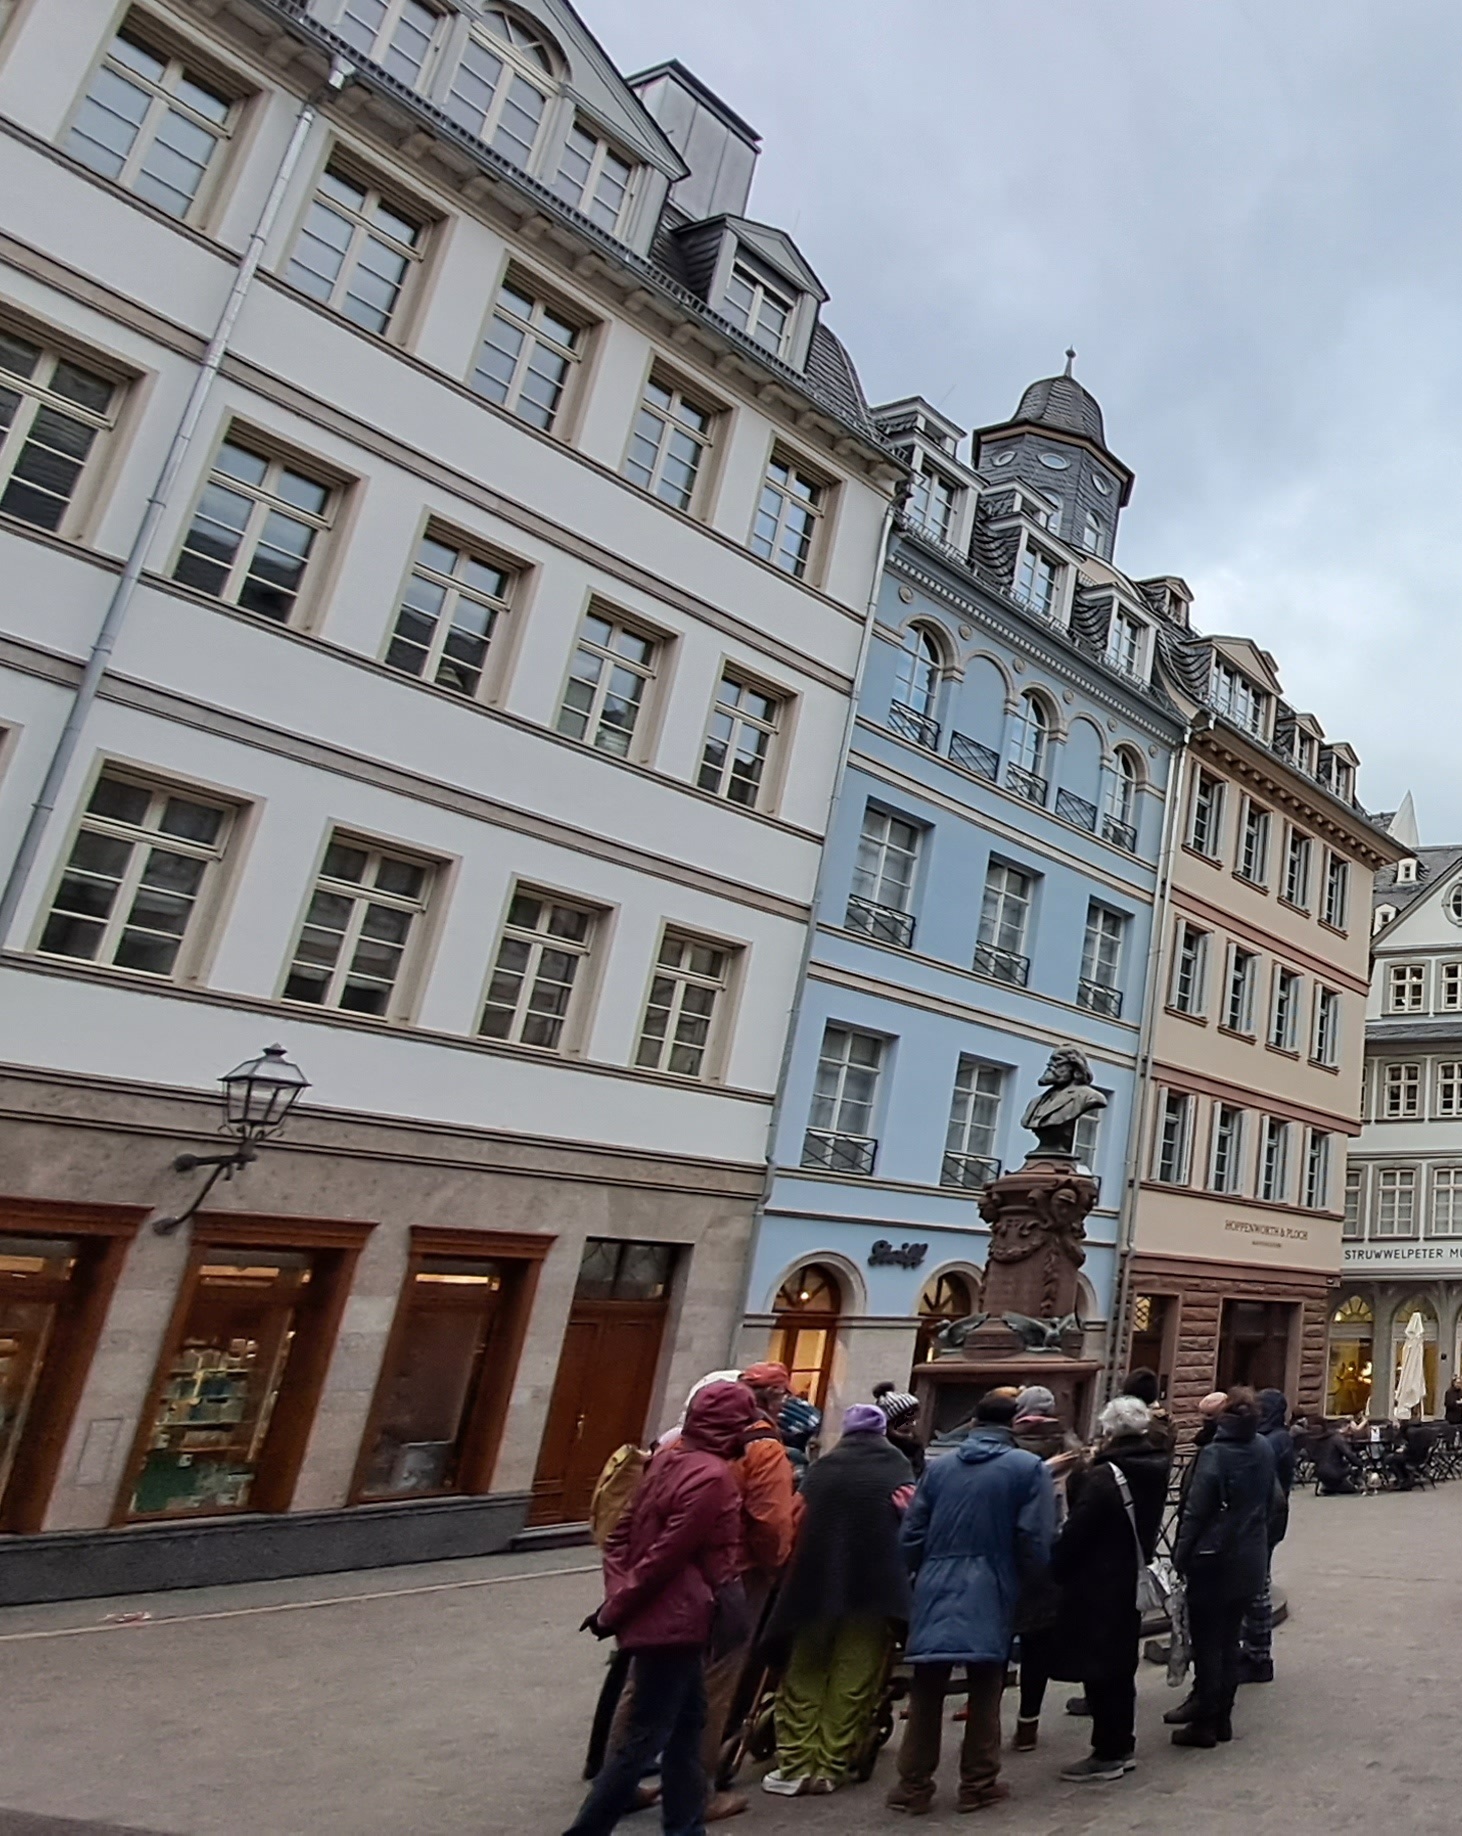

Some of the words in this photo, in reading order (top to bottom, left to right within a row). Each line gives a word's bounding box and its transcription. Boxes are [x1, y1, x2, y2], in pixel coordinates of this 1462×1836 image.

[1224, 1219, 1279, 1236] HOPPENWORTH
[1279, 1227, 1285, 1238] &
[1285, 1228, 1309, 1241] PLOCH
[1344, 1249, 1444, 1260] STRUWWELPETER
